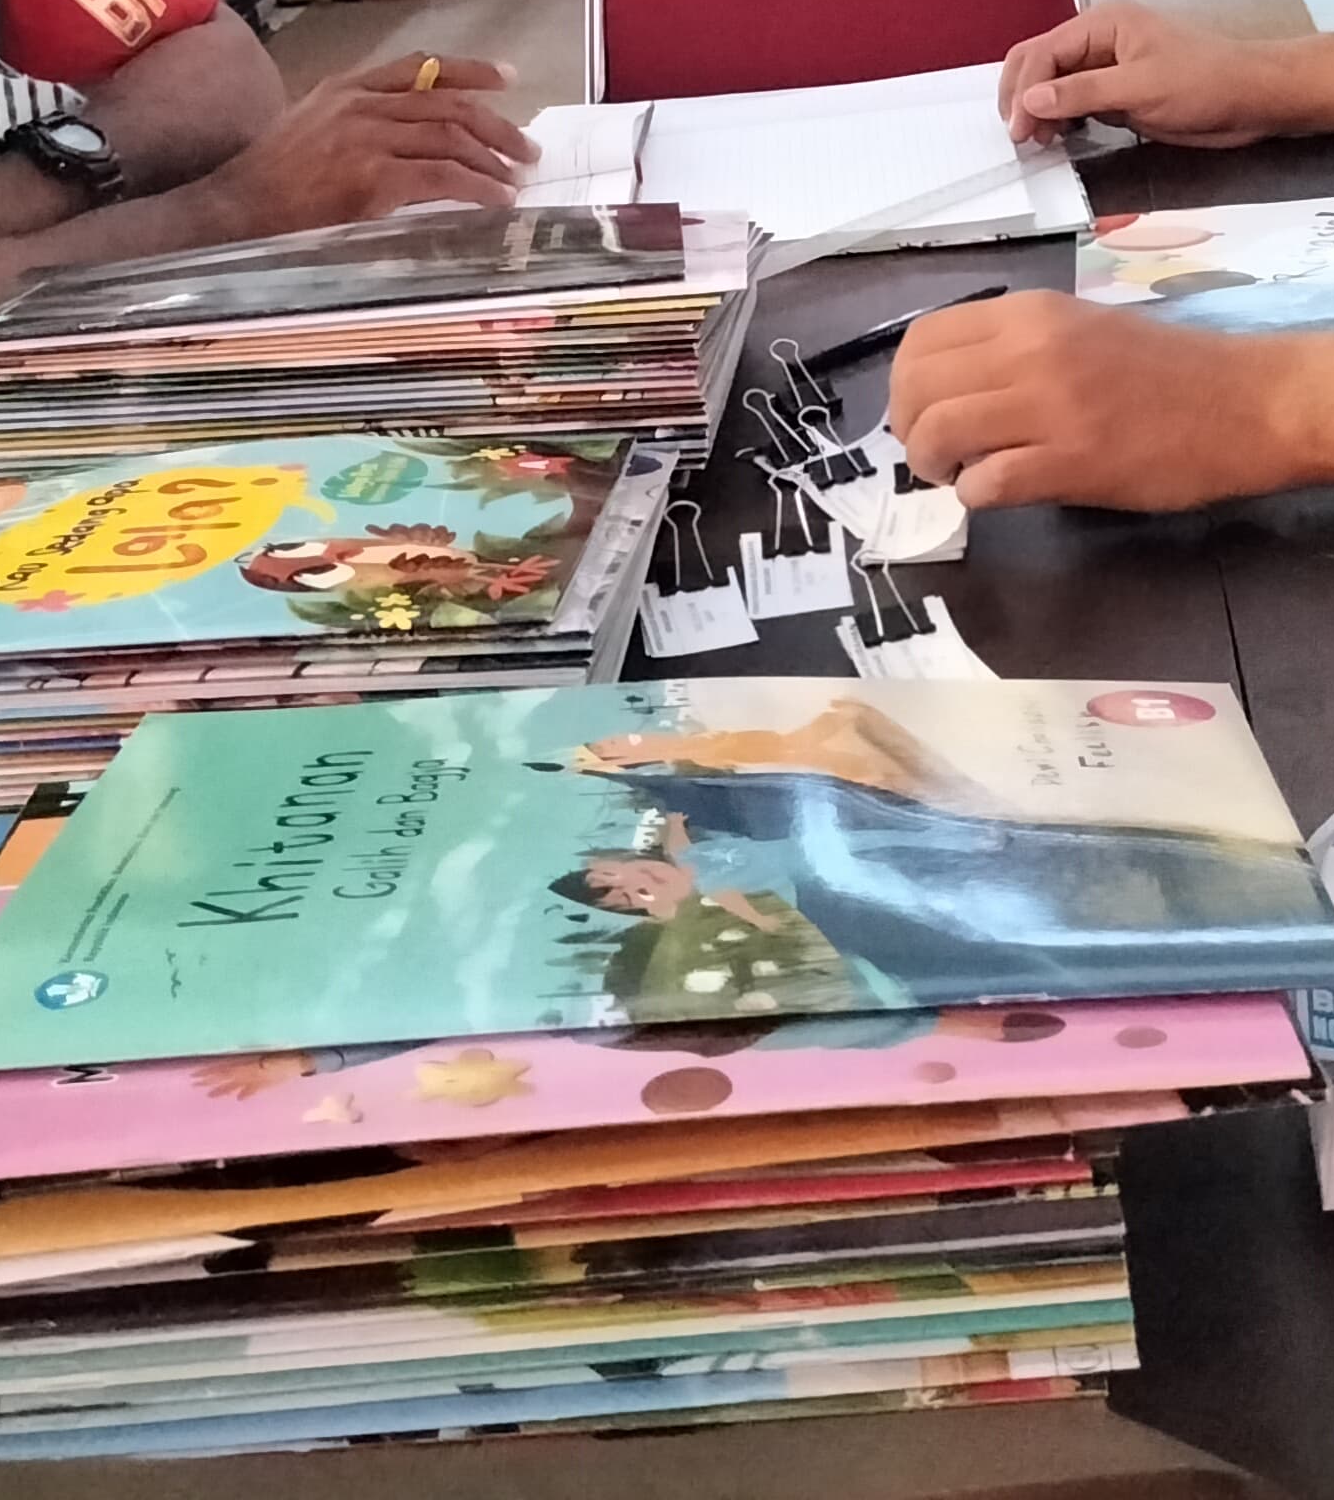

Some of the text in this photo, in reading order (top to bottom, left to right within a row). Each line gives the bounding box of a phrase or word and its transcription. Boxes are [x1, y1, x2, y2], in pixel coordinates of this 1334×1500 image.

[86, 478, 152, 507] apa
[1133, 698, 1174, 726] B1
[176, 750, 374, 928] Khitanan
[332, 757, 471, 899] Galih dan Bagja
